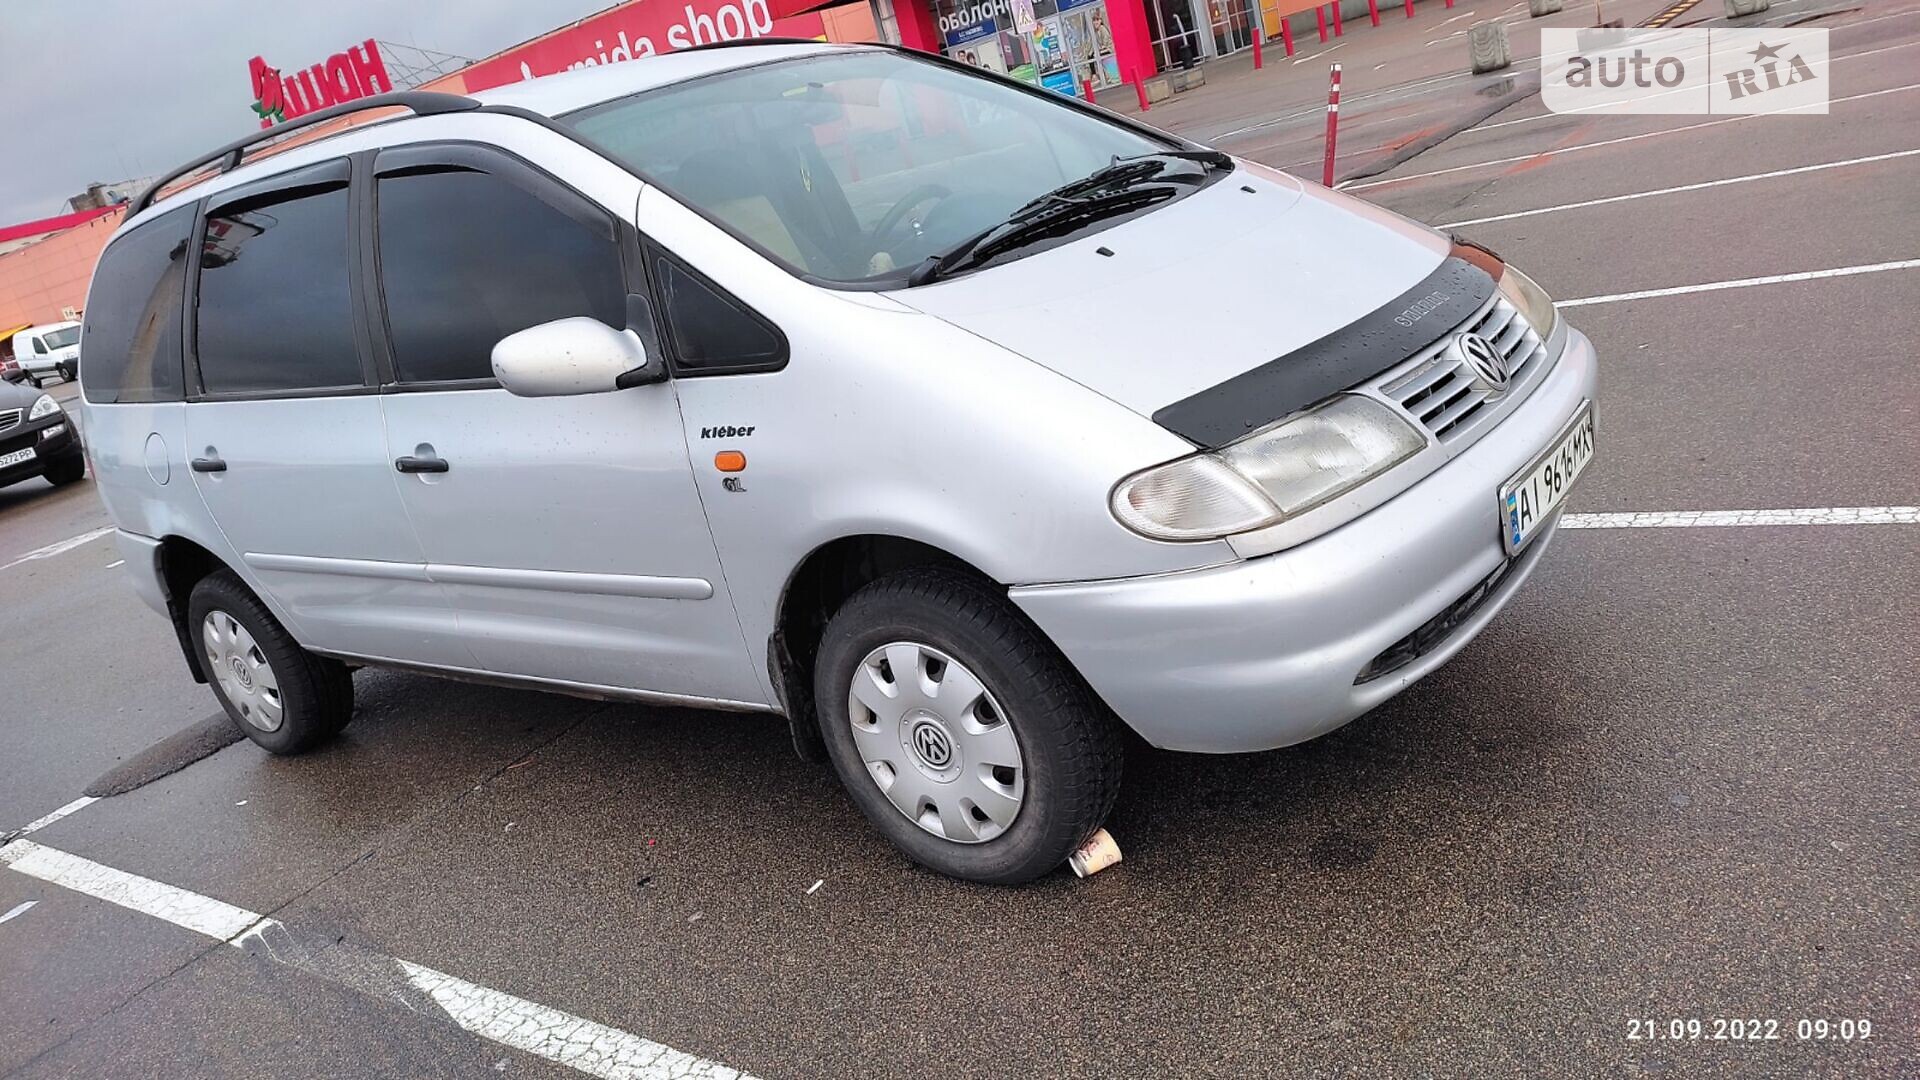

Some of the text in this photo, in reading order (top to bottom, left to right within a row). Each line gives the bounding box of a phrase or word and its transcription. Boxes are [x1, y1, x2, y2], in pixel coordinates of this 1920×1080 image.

[667, 0, 773, 49] shop
[700, 426, 755, 439] kléber
[1520, 477, 1539, 531] AI
[1544, 440, 1572, 504] 9616
